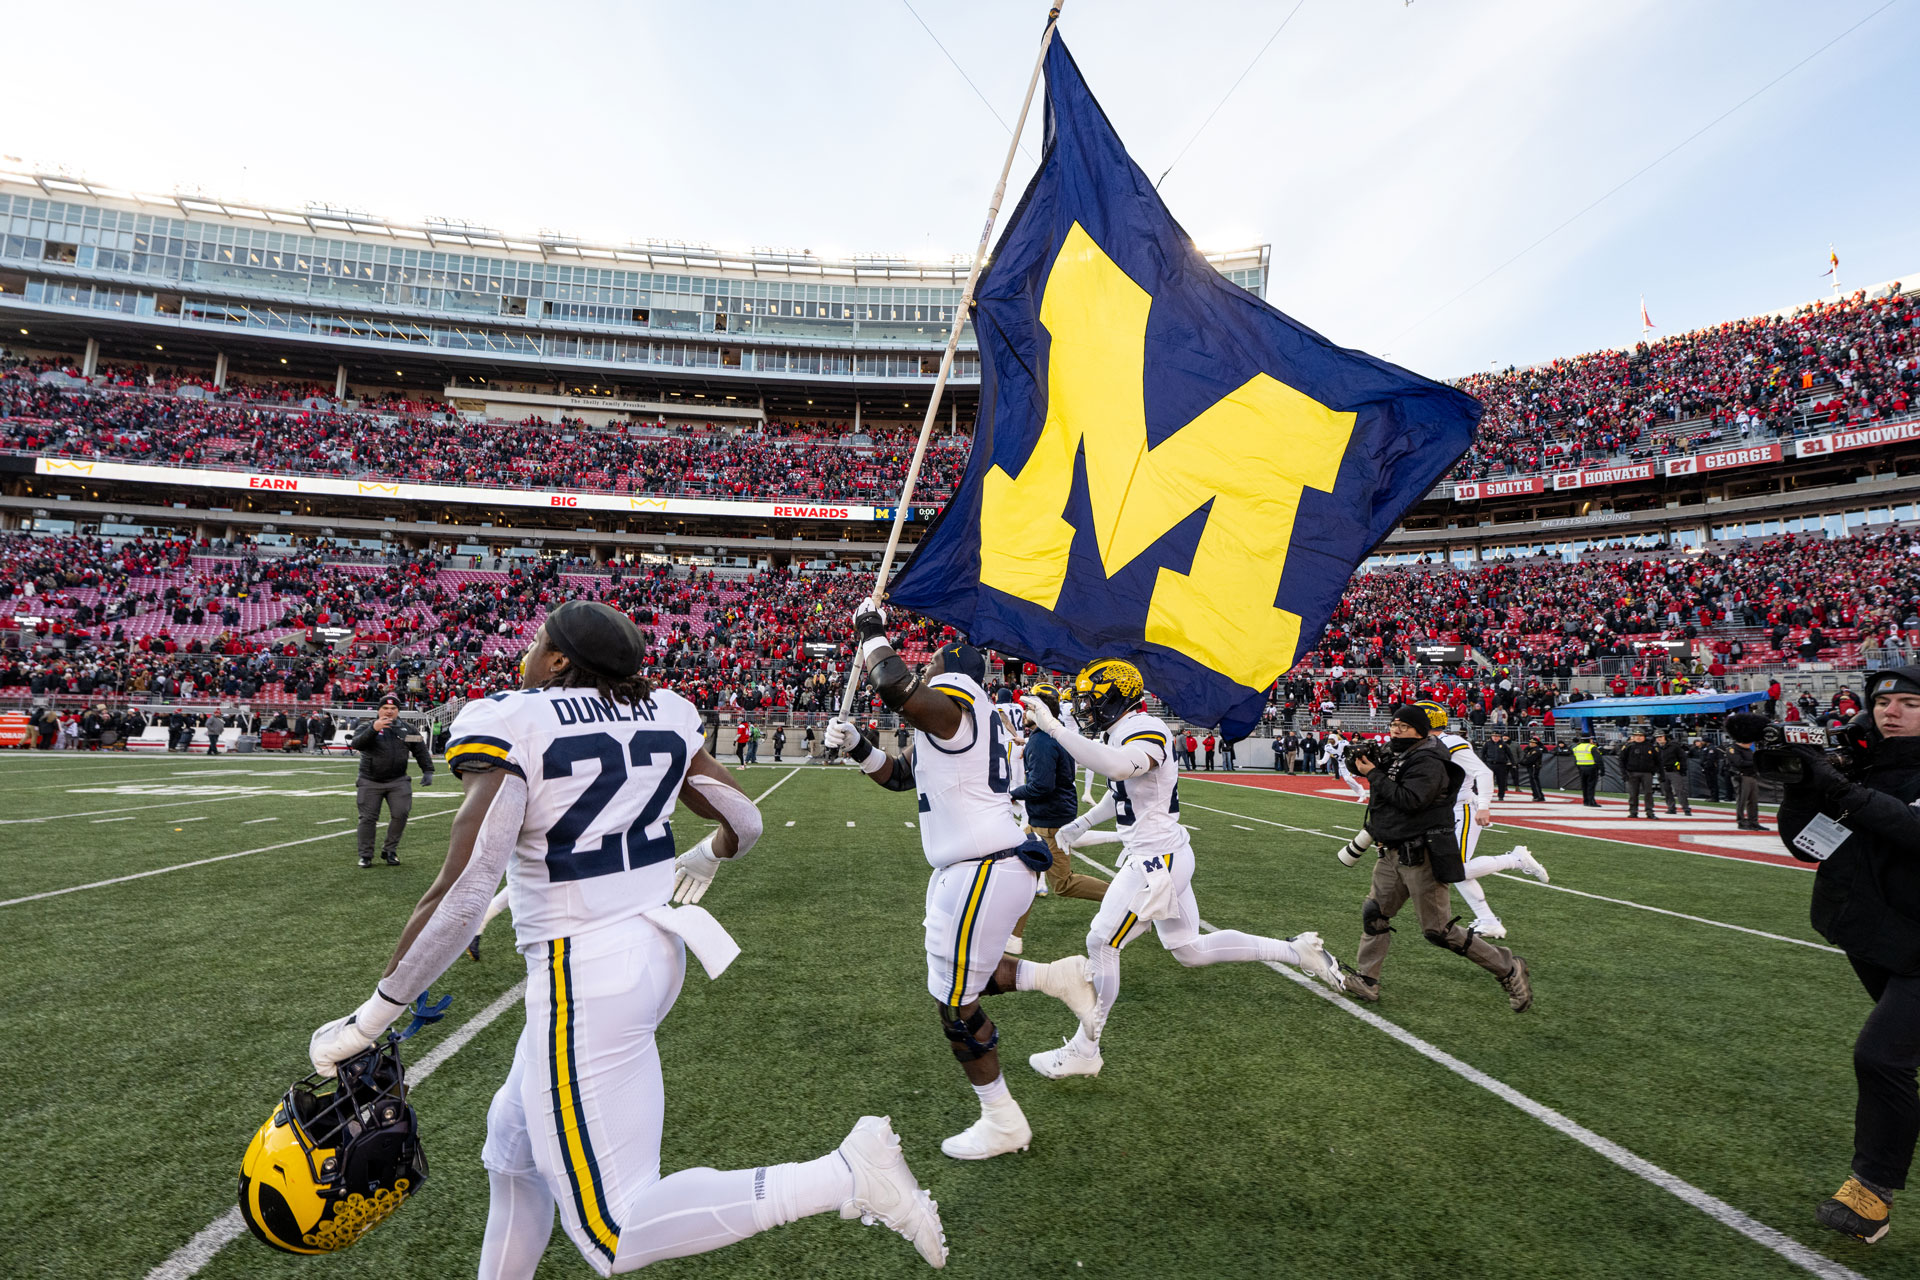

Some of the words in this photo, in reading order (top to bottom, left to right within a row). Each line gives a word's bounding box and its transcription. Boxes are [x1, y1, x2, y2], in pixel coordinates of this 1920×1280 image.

[1802, 440, 1827, 455] 31
[980, 220, 1358, 694] M
[1670, 460, 1691, 474] 27
[1705, 446, 1772, 468] GEORGE
[249, 477, 298, 490] EARN
[1557, 475, 1577, 488] 22
[1584, 464, 1650, 485] HORVATH
[1458, 486, 1475, 498] 10
[1486, 480, 1533, 496] SMITH
[550, 496, 577, 507] BIG
[773, 506, 849, 519] REWARDS
[875, 508, 889, 519] M
[919, 508, 935, 516] 0:00
[1585, 512, 1630, 523] LANDING
[551, 696, 658, 725] DUNLAP
[1009, 708, 1023, 731] 12
[542, 730, 675, 883] 22
[1143, 856, 1164, 873] M
